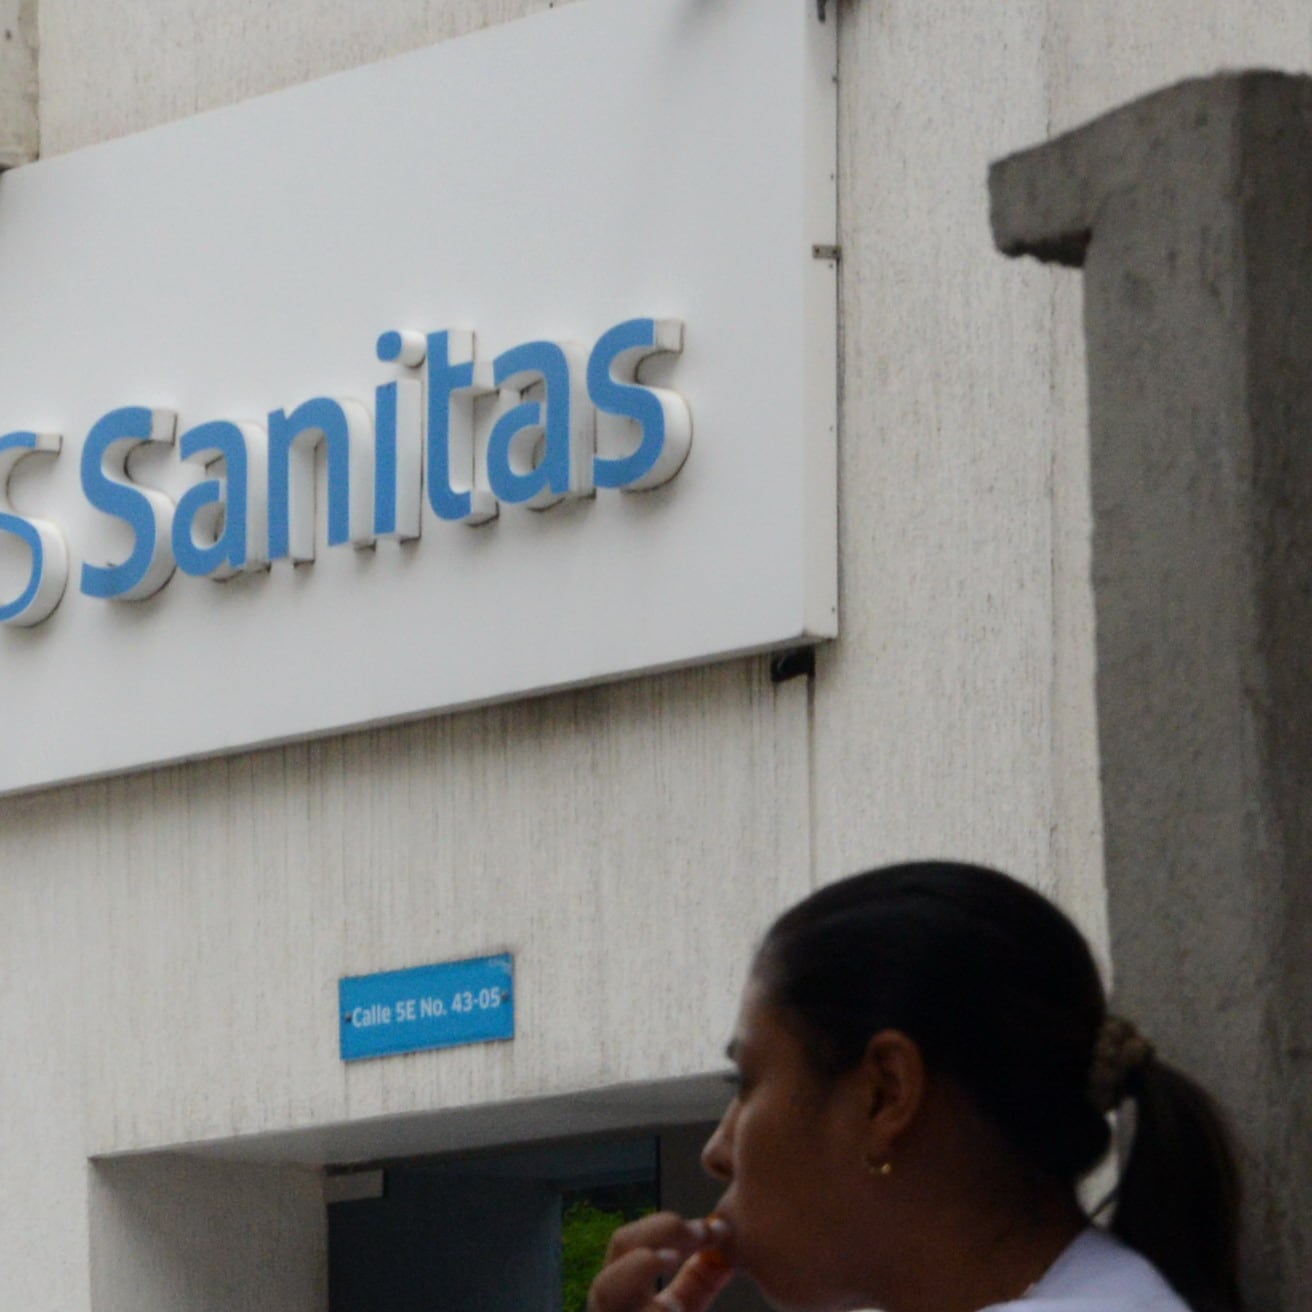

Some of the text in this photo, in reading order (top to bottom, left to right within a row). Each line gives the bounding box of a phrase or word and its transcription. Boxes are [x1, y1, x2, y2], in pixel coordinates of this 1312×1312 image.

[351, 987, 502, 1028] Calle 5E No. 43-05
